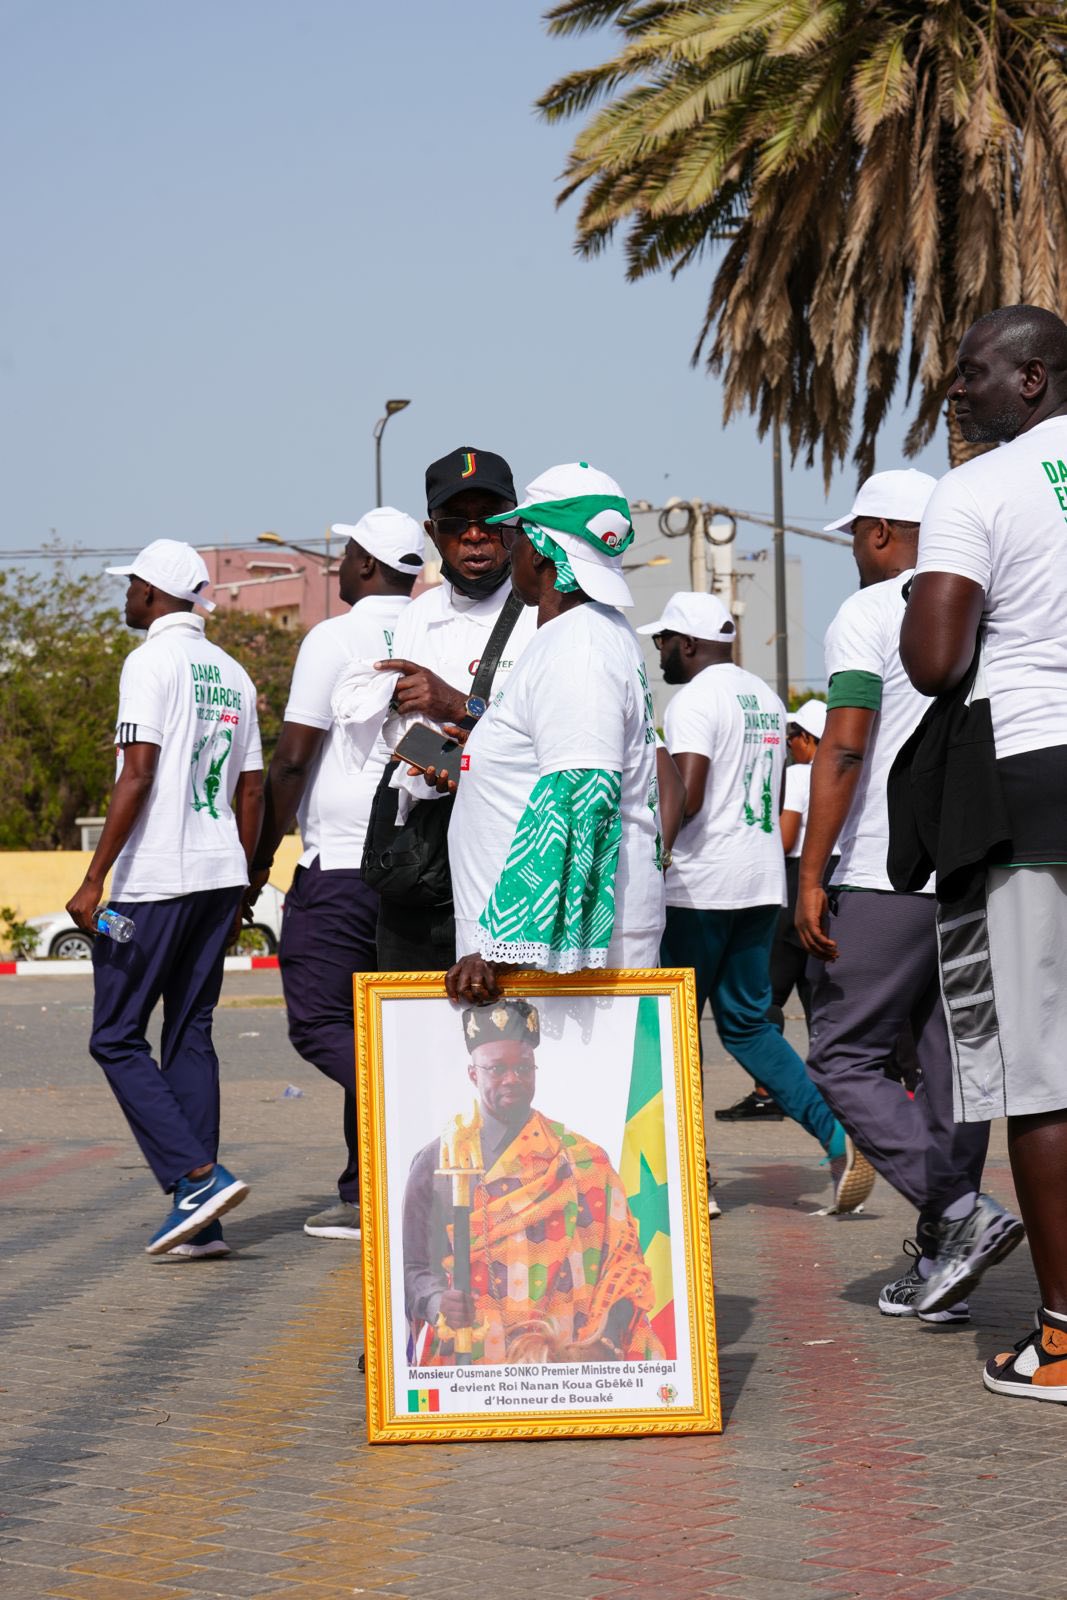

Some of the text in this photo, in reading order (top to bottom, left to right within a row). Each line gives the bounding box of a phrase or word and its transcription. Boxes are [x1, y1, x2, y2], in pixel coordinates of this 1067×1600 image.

[408, 1362, 676, 1380] Monsieur Ousmane SONKO Premier Ministre du Sénégal
[450, 1378, 643, 1392] devient Roi Nanan Koua Gbêkê II
[484, 1393, 613, 1406] d’Honneur de Bouaké
